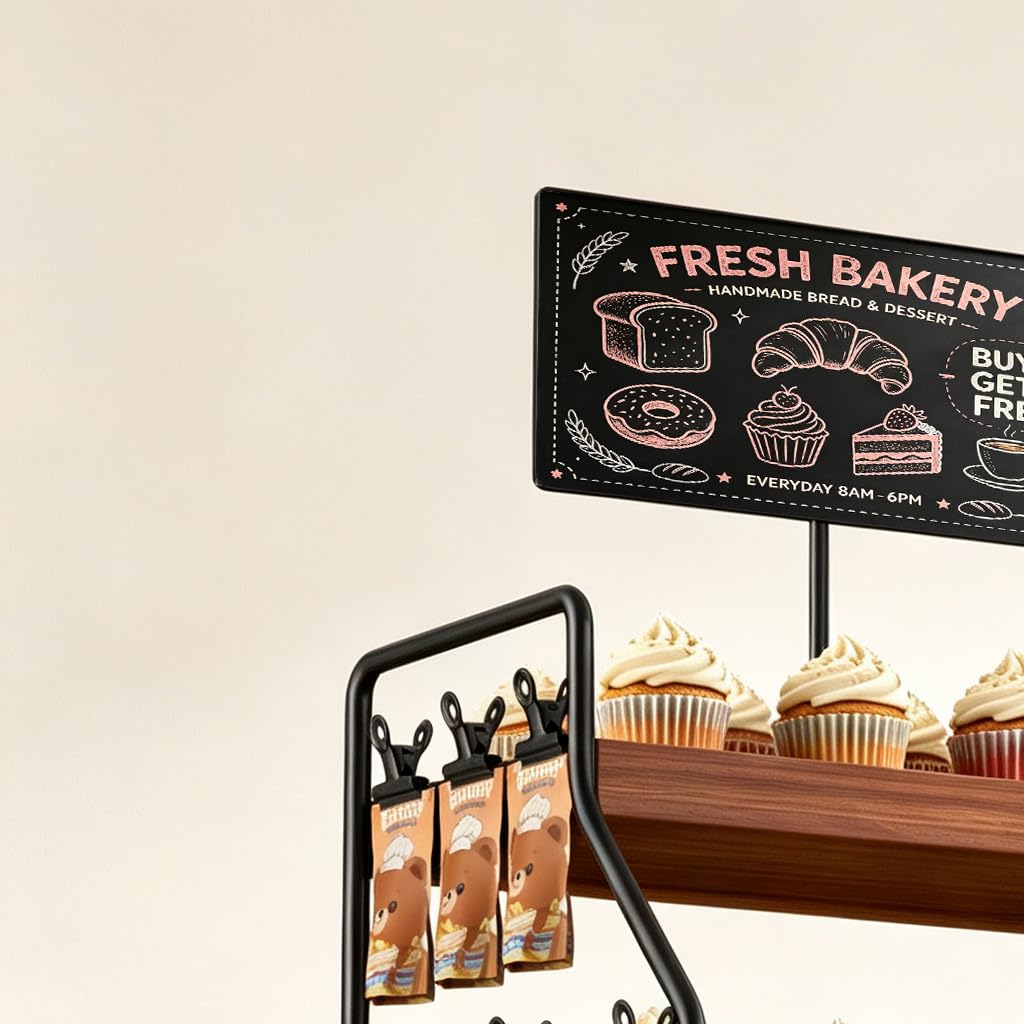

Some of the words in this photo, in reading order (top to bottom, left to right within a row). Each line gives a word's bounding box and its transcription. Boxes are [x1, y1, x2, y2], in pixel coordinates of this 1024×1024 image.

[650, 244, 811, 281] FRESH
[832, 253, 1024, 322] BAKERY
[708, 285, 802, 301] HANDMADE
[807, 291, 862, 309] BREAD
[867, 300, 879, 312] &
[884, 303, 958, 327] DESSERT
[746, 474, 833, 495] EVERYDAY
[838, 485, 874, 500] 8AM
[887, 491, 922, 506] 6PM
